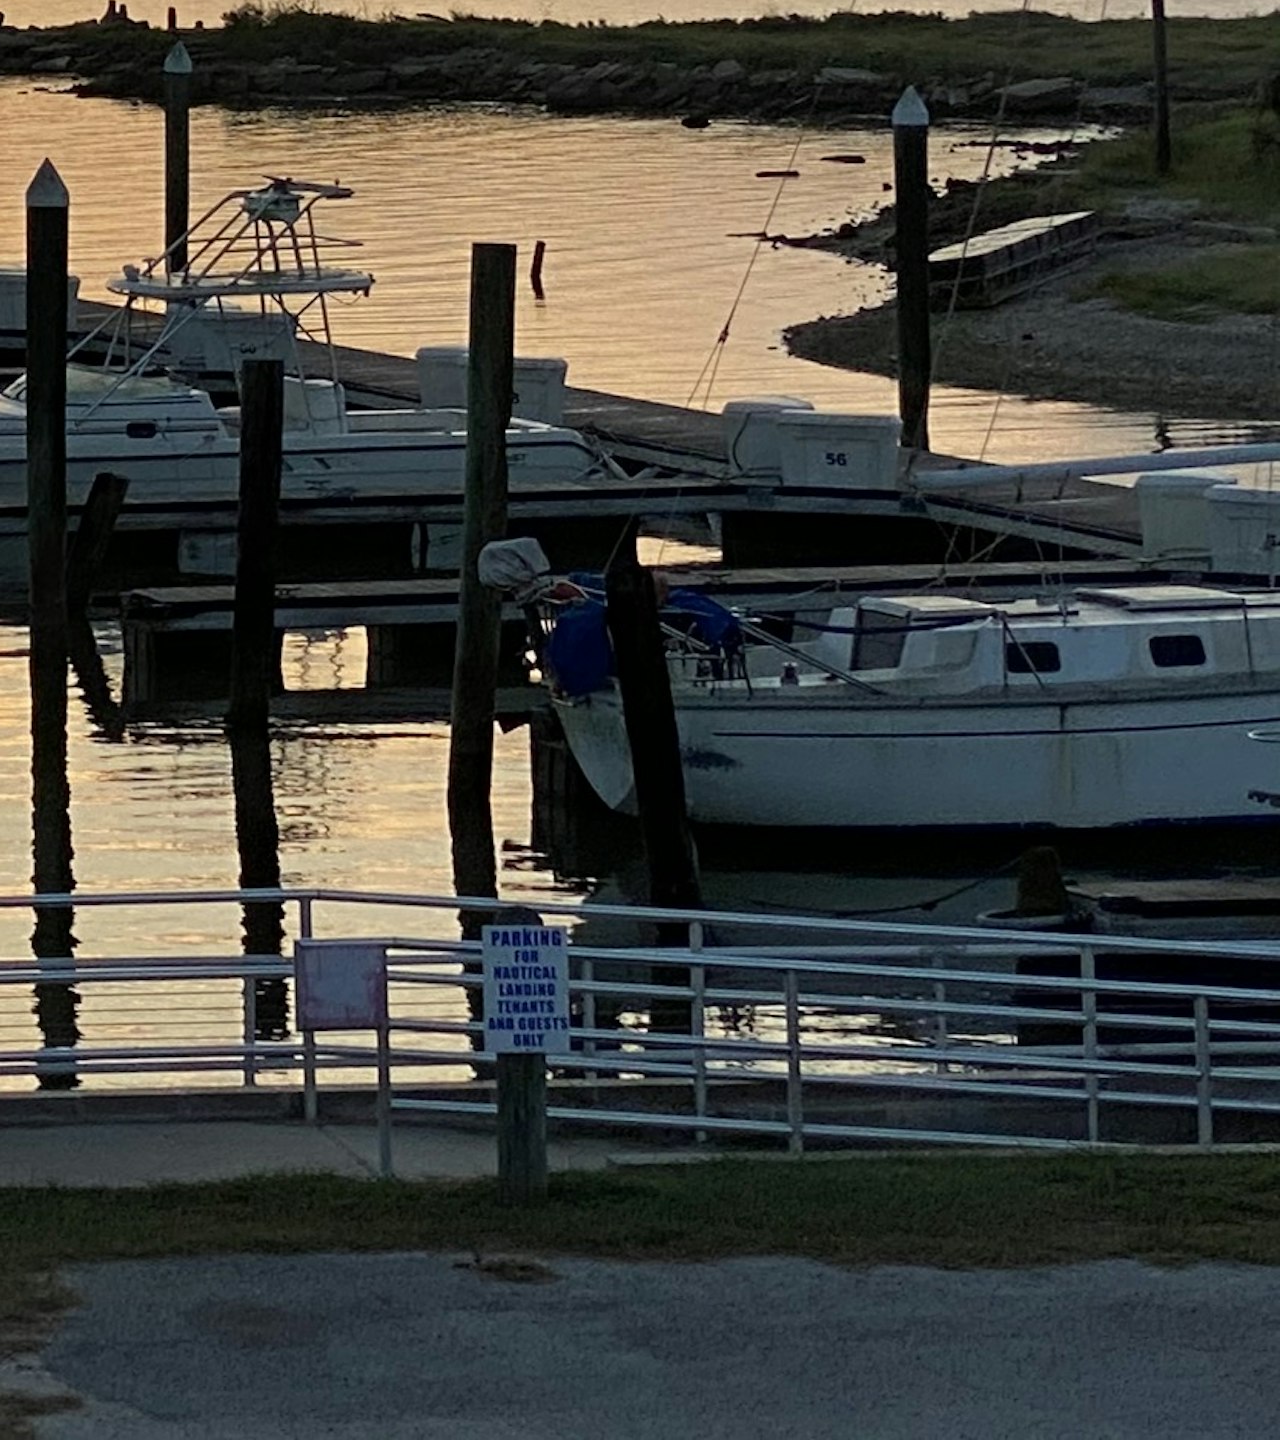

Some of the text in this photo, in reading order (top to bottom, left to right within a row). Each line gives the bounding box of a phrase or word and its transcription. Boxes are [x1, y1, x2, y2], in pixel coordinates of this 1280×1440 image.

[825, 452, 847, 466] 56
[491, 930, 561, 947] PARKING
[514, 950, 539, 963] FOR
[493, 966, 557, 980] NAUTICAL
[499, 983, 556, 997] LANDING
[497, 1000, 554, 1013] TENANTS
[488, 1016, 568, 1030] AND GUESTS
[513, 1034, 545, 1047] ONLY
